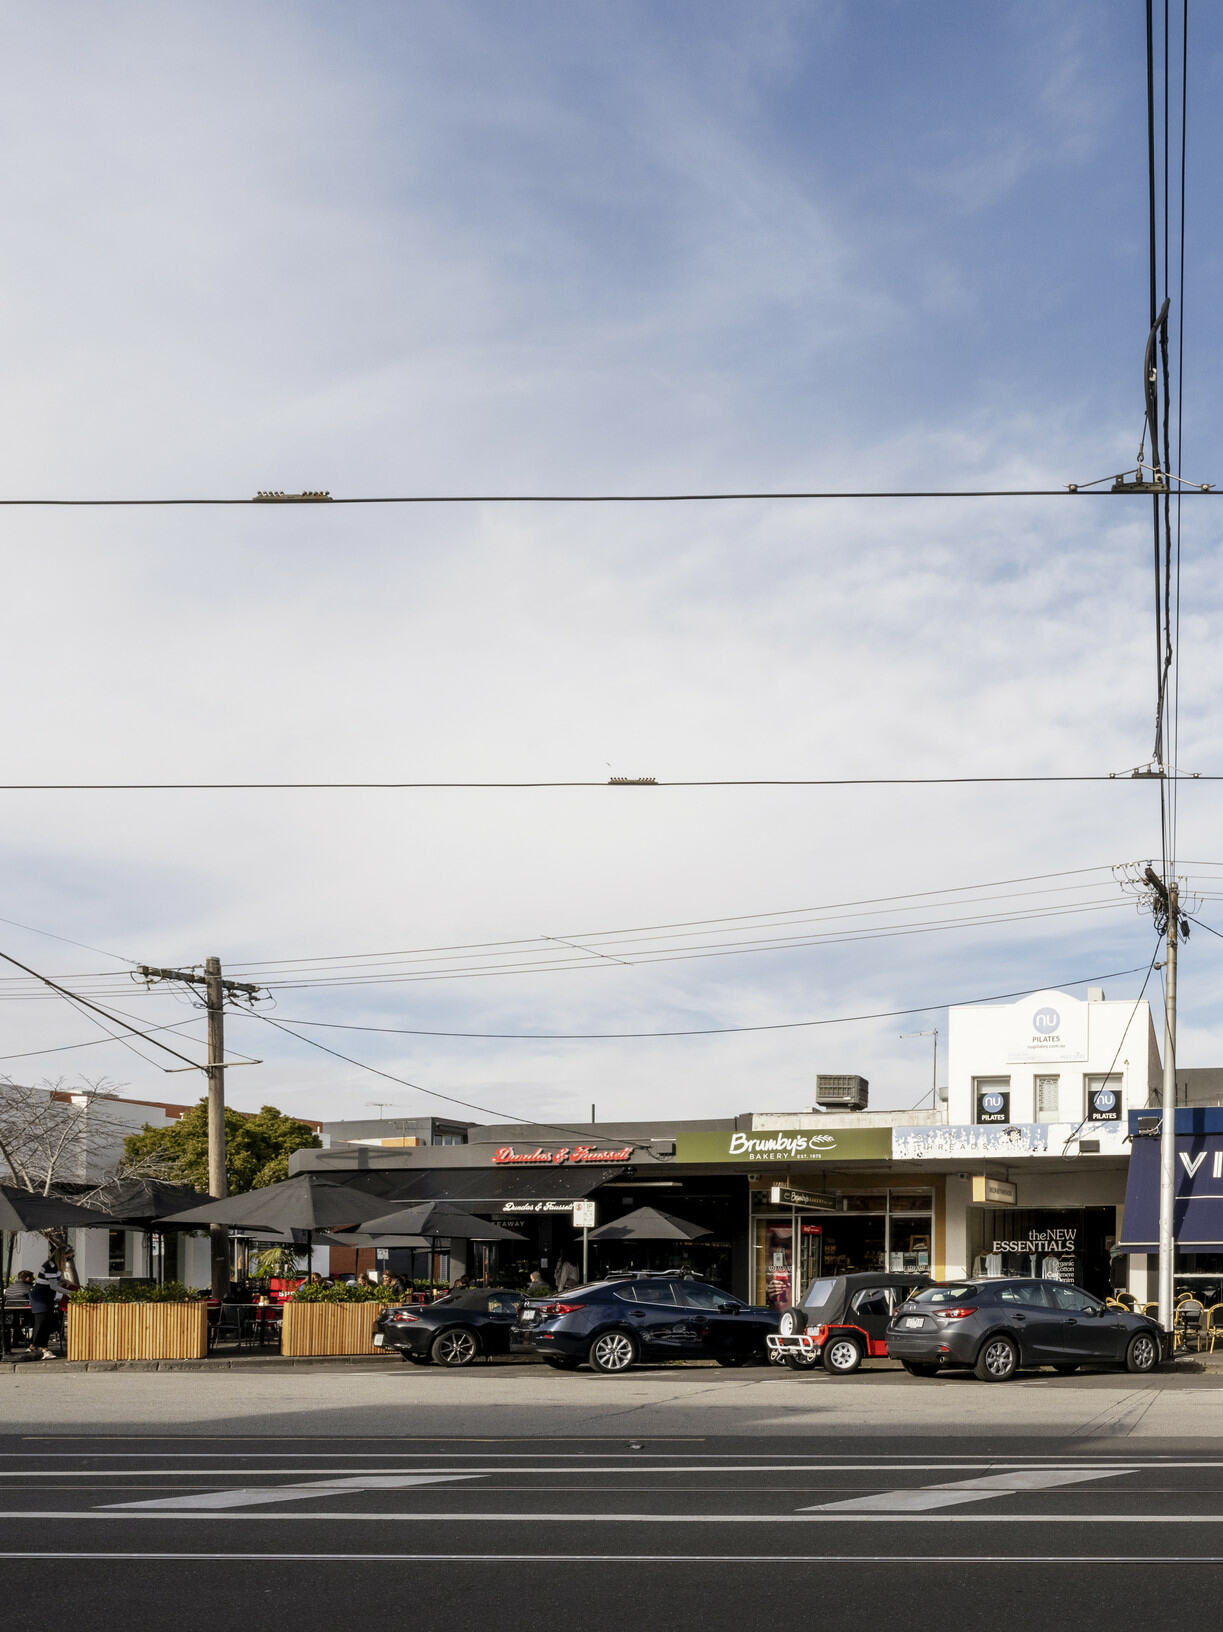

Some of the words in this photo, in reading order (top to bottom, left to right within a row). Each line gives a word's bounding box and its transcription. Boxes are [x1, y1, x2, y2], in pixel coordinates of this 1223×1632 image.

[1036, 1013, 1057, 1026] nu
[1032, 1035, 1061, 1043] PILATES
[984, 1097, 1001, 1107] nu
[1096, 1095, 1113, 1105] nu
[1092, 1112, 1117, 1120] PILATES
[728, 1132, 808, 1157] Brumby's
[492, 1147, 553, 1164] Dundas
[552, 1147, 569, 1164] &
[749, 1152, 789, 1160] BAKERY
[503, 1202, 534, 1212] Dundas
[534, 1203, 543, 1212] &
[993, 1240, 1075, 1252] ESSENTIALS
